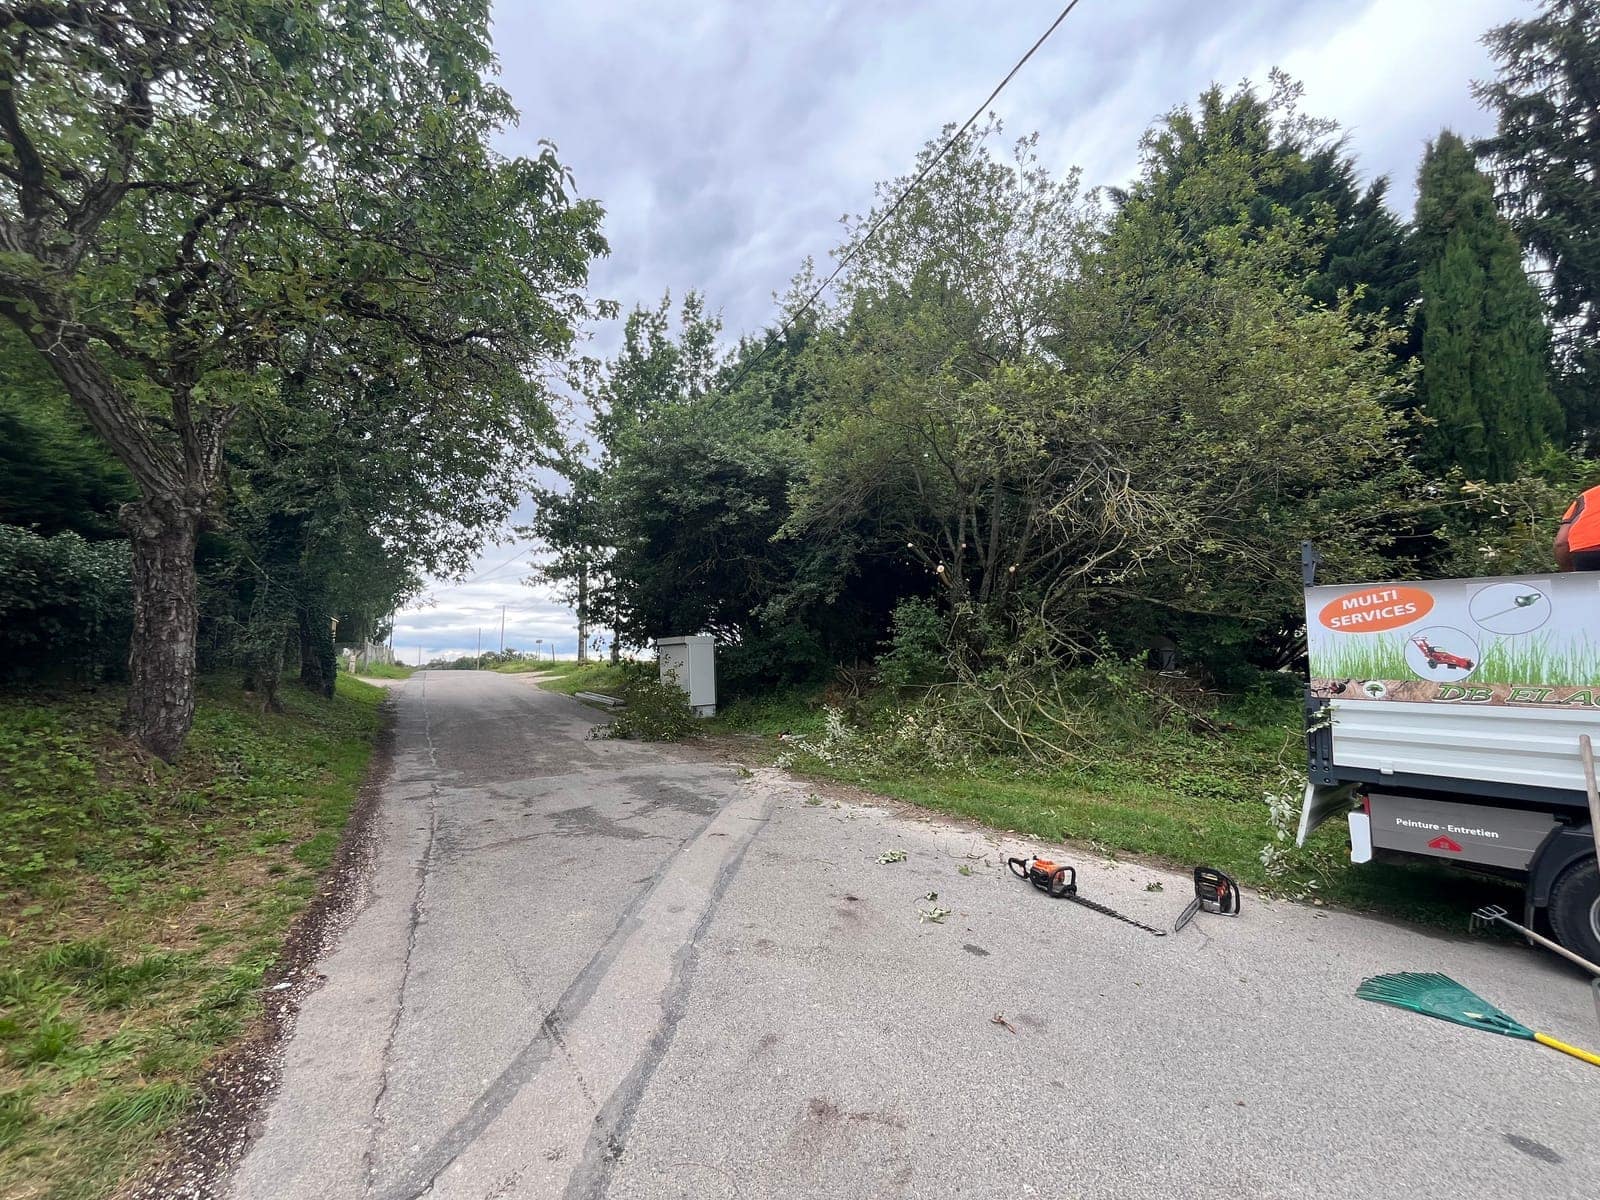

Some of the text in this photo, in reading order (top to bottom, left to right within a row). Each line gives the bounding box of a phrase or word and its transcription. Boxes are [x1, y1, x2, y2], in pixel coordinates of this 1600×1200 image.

[1342, 589, 1398, 610] MULTI
[1330, 602, 1417, 628] SERVICES
[1432, 684, 1494, 703] DB
[1396, 818, 1440, 831] Peinture
[1447, 824, 1499, 839] Entretien
